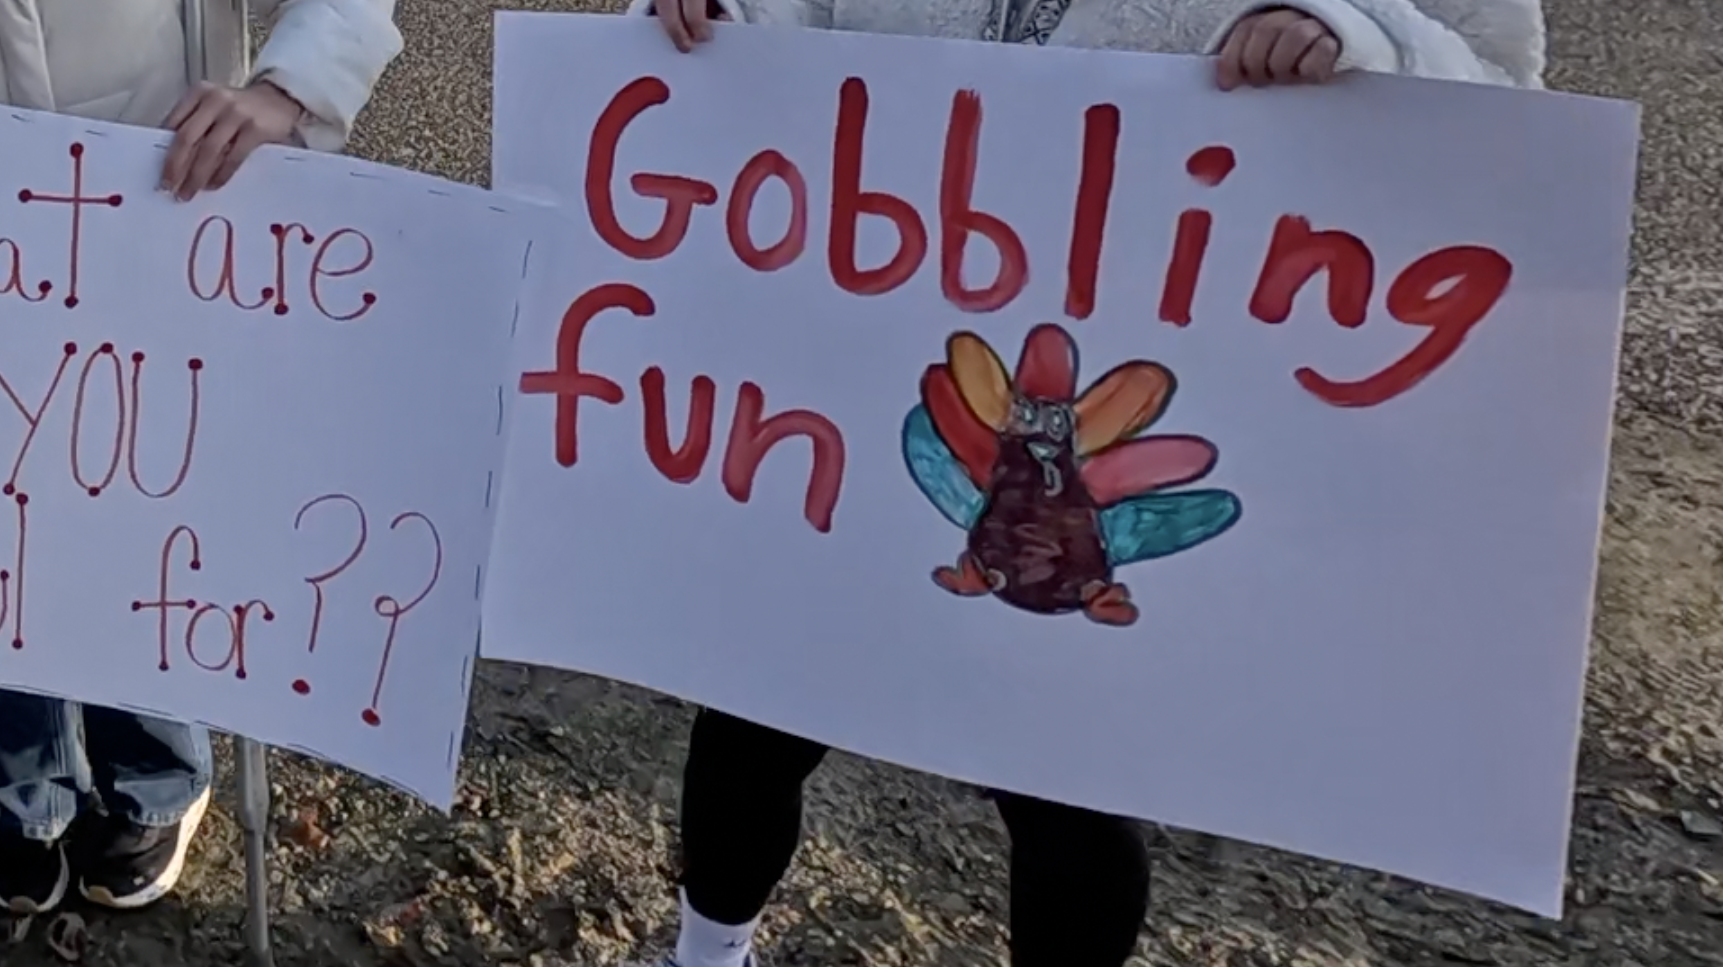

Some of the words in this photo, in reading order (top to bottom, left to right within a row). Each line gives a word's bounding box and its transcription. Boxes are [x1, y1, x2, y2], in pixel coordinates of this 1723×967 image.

[187, 215, 378, 321] are
[584, 75, 1515, 409] Gobbling
[518, 281, 846, 534] fun
